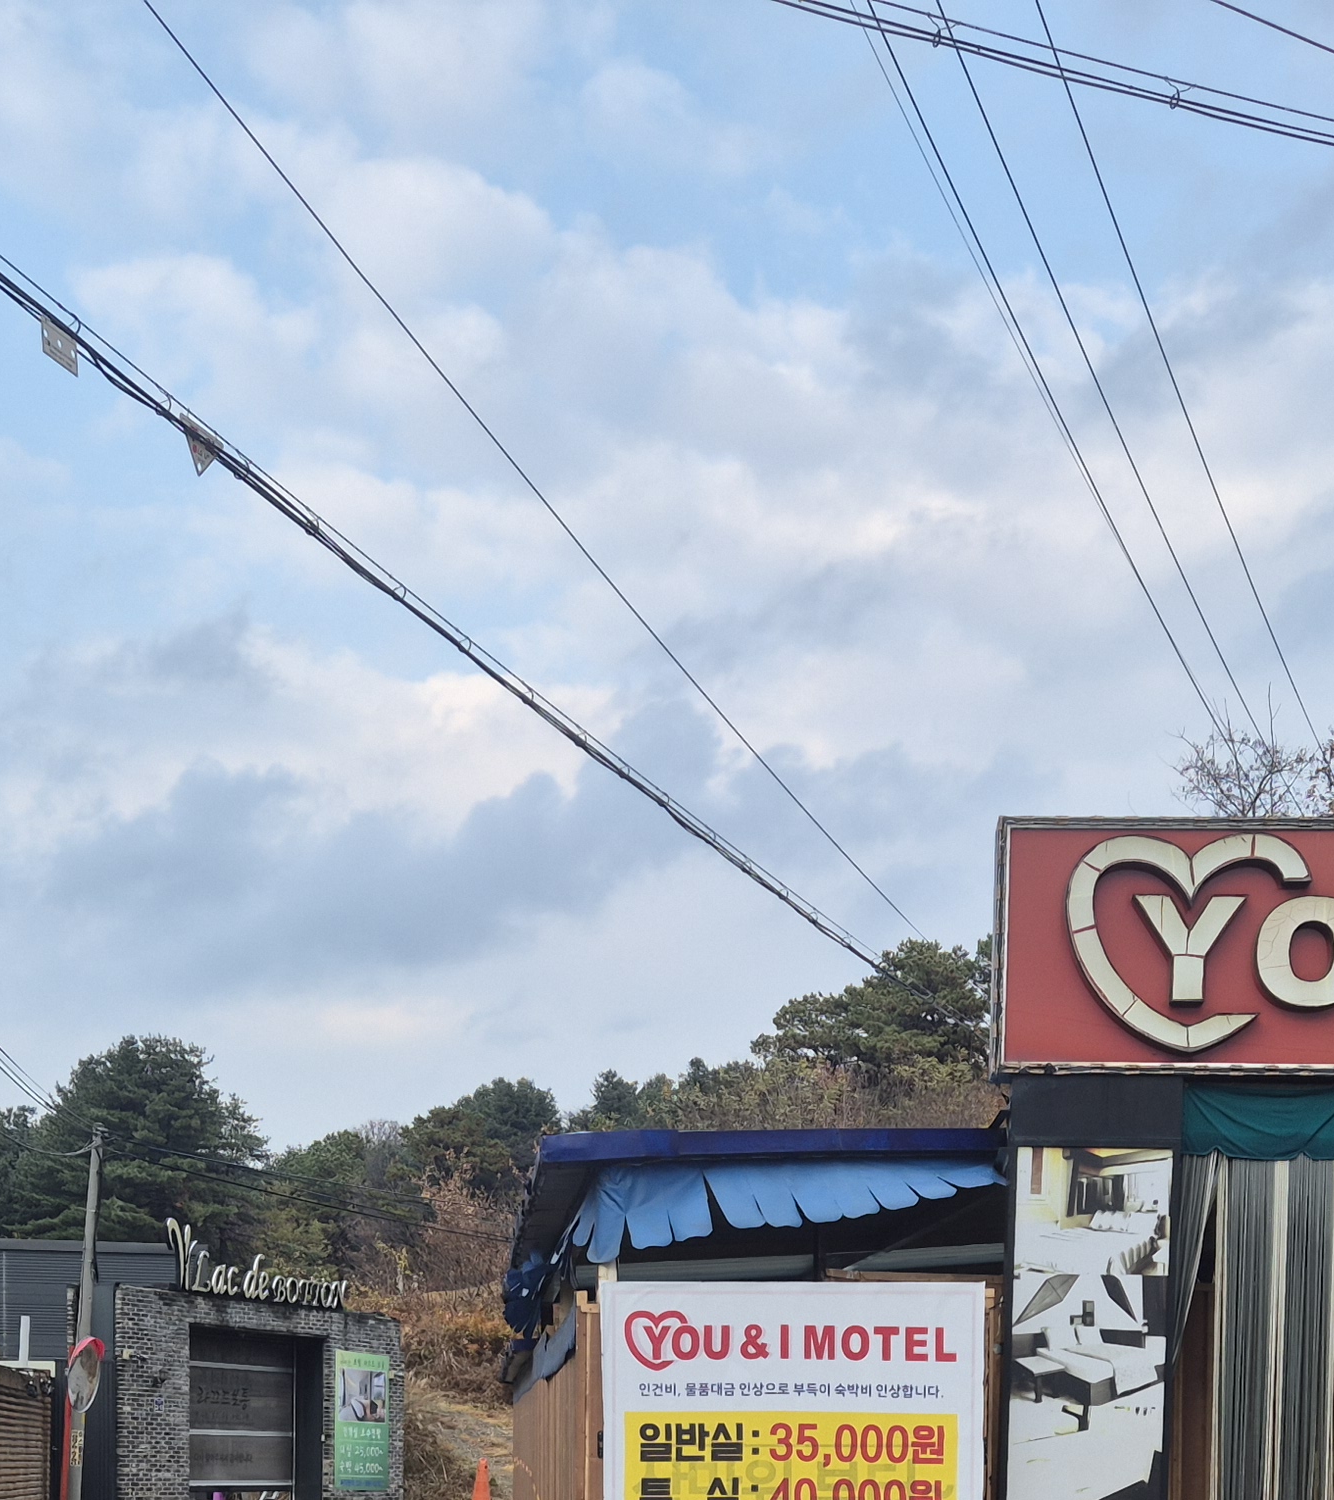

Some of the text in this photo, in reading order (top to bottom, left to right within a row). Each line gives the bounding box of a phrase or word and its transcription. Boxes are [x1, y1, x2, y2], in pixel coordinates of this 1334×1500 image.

[642, 1323, 958, 1363] YOU & I MOTEL
[638, 1382, 944, 1399] 인건비, 물품대금 인상으로 부득이 숙박비 인상합니다.
[768, 1422, 945, 1468] 35,000원
